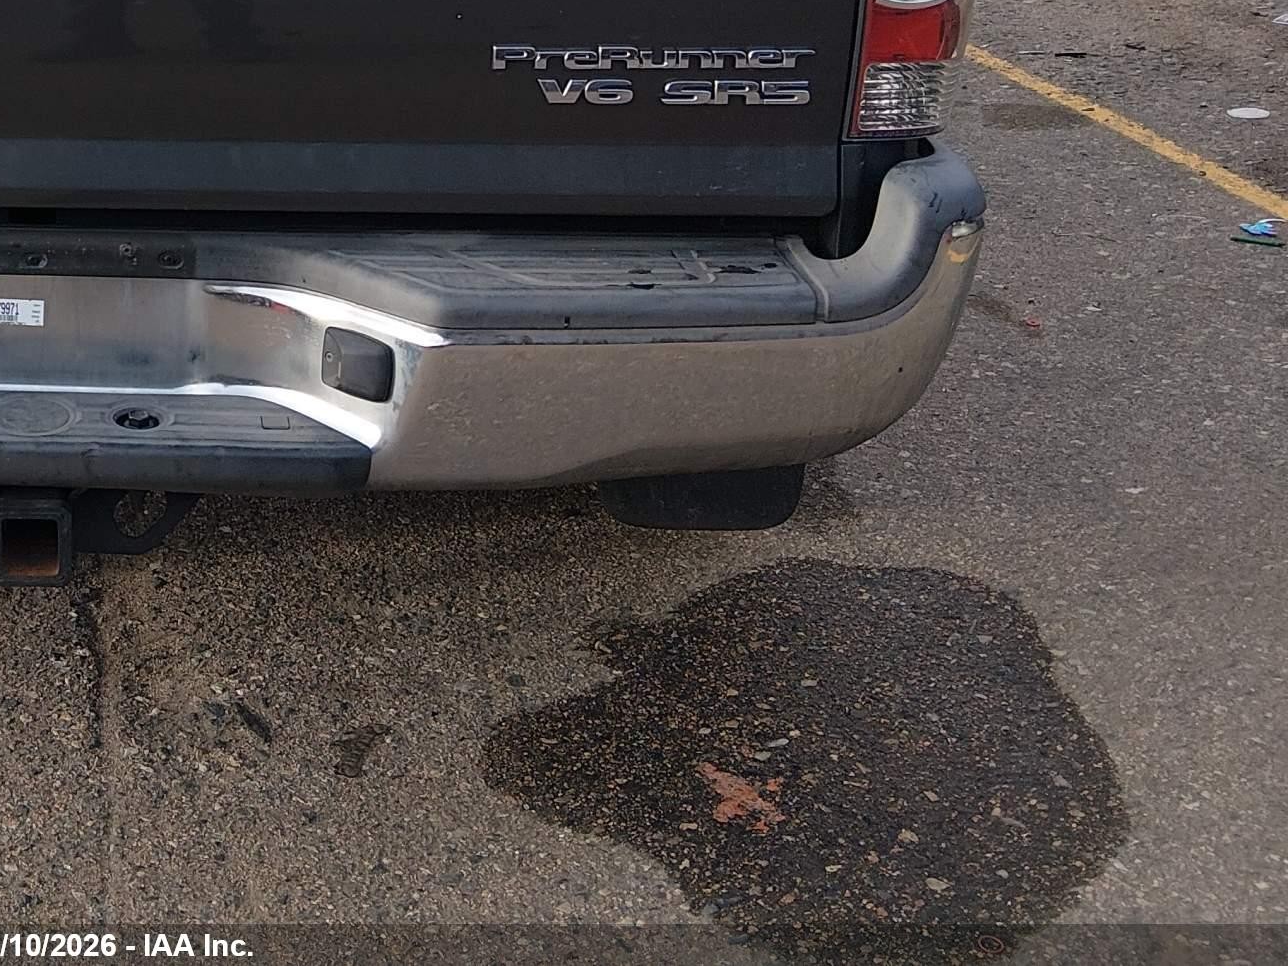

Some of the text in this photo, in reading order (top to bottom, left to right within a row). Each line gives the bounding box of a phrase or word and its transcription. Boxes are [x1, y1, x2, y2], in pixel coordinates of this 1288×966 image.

[492, 45, 815, 70] PreRunner
[537, 79, 811, 105] V6 SR5
